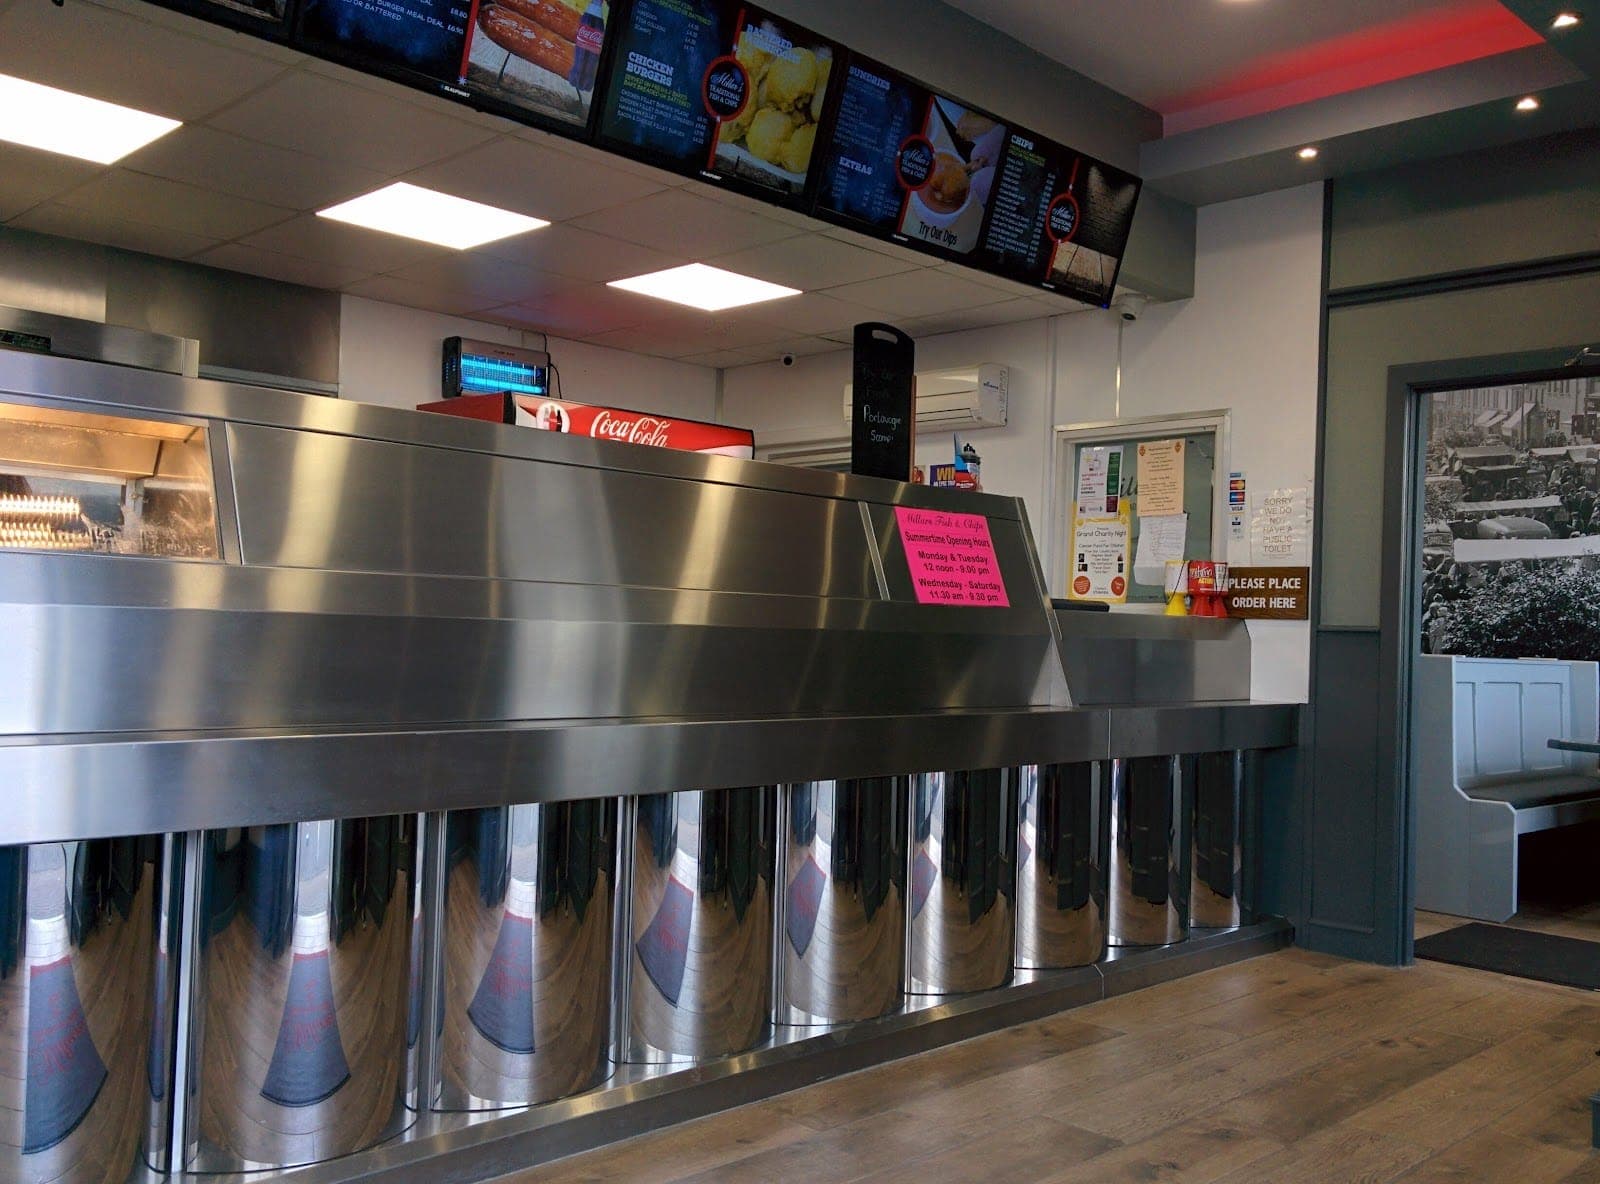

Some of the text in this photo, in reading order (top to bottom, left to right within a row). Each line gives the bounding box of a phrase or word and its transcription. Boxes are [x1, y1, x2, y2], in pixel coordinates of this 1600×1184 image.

[364, 4, 402, 21] BATTERED
[406, 9, 425, 21] MEAL
[426, 16, 444, 28] DEAL
[628, 51, 674, 77] CHICKEN
[625, 61, 673, 87] BURGERS
[849, 65, 890, 91] SUNDRIES
[709, 84, 741, 102] TRADITIONAL
[1010, 134, 1034, 151] CHIPS
[839, 156, 873, 176] EXTRAS
[919, 221, 958, 245] Try Our Dips
[590, 410, 671, 448] Coca-Cola
[1263, 497, 1293, 506] SORRY
[1264, 506, 1292, 515] WE DO
[934, 515, 953, 529] Fish
[963, 518, 984, 533] Chips
[904, 531, 991, 548] Summertime Opening Hours
[1095, 530, 1114, 538] Charity
[1263, 544, 1293, 553] TOILET
[917, 550, 988, 565] Monday & Tuesday
[923, 563, 934, 571] 12
[936, 565, 954, 573] noon
[978, 567, 990, 575] pm
[918, 578, 962, 591] Wednesday
[968, 580, 1001, 593] Saturday
[1228, 577, 1265, 589] PLEASE
[1268, 577, 1302, 590] PLACE
[952, 592, 964, 600] am
[1232, 596, 1297, 609] ORDER HERE
